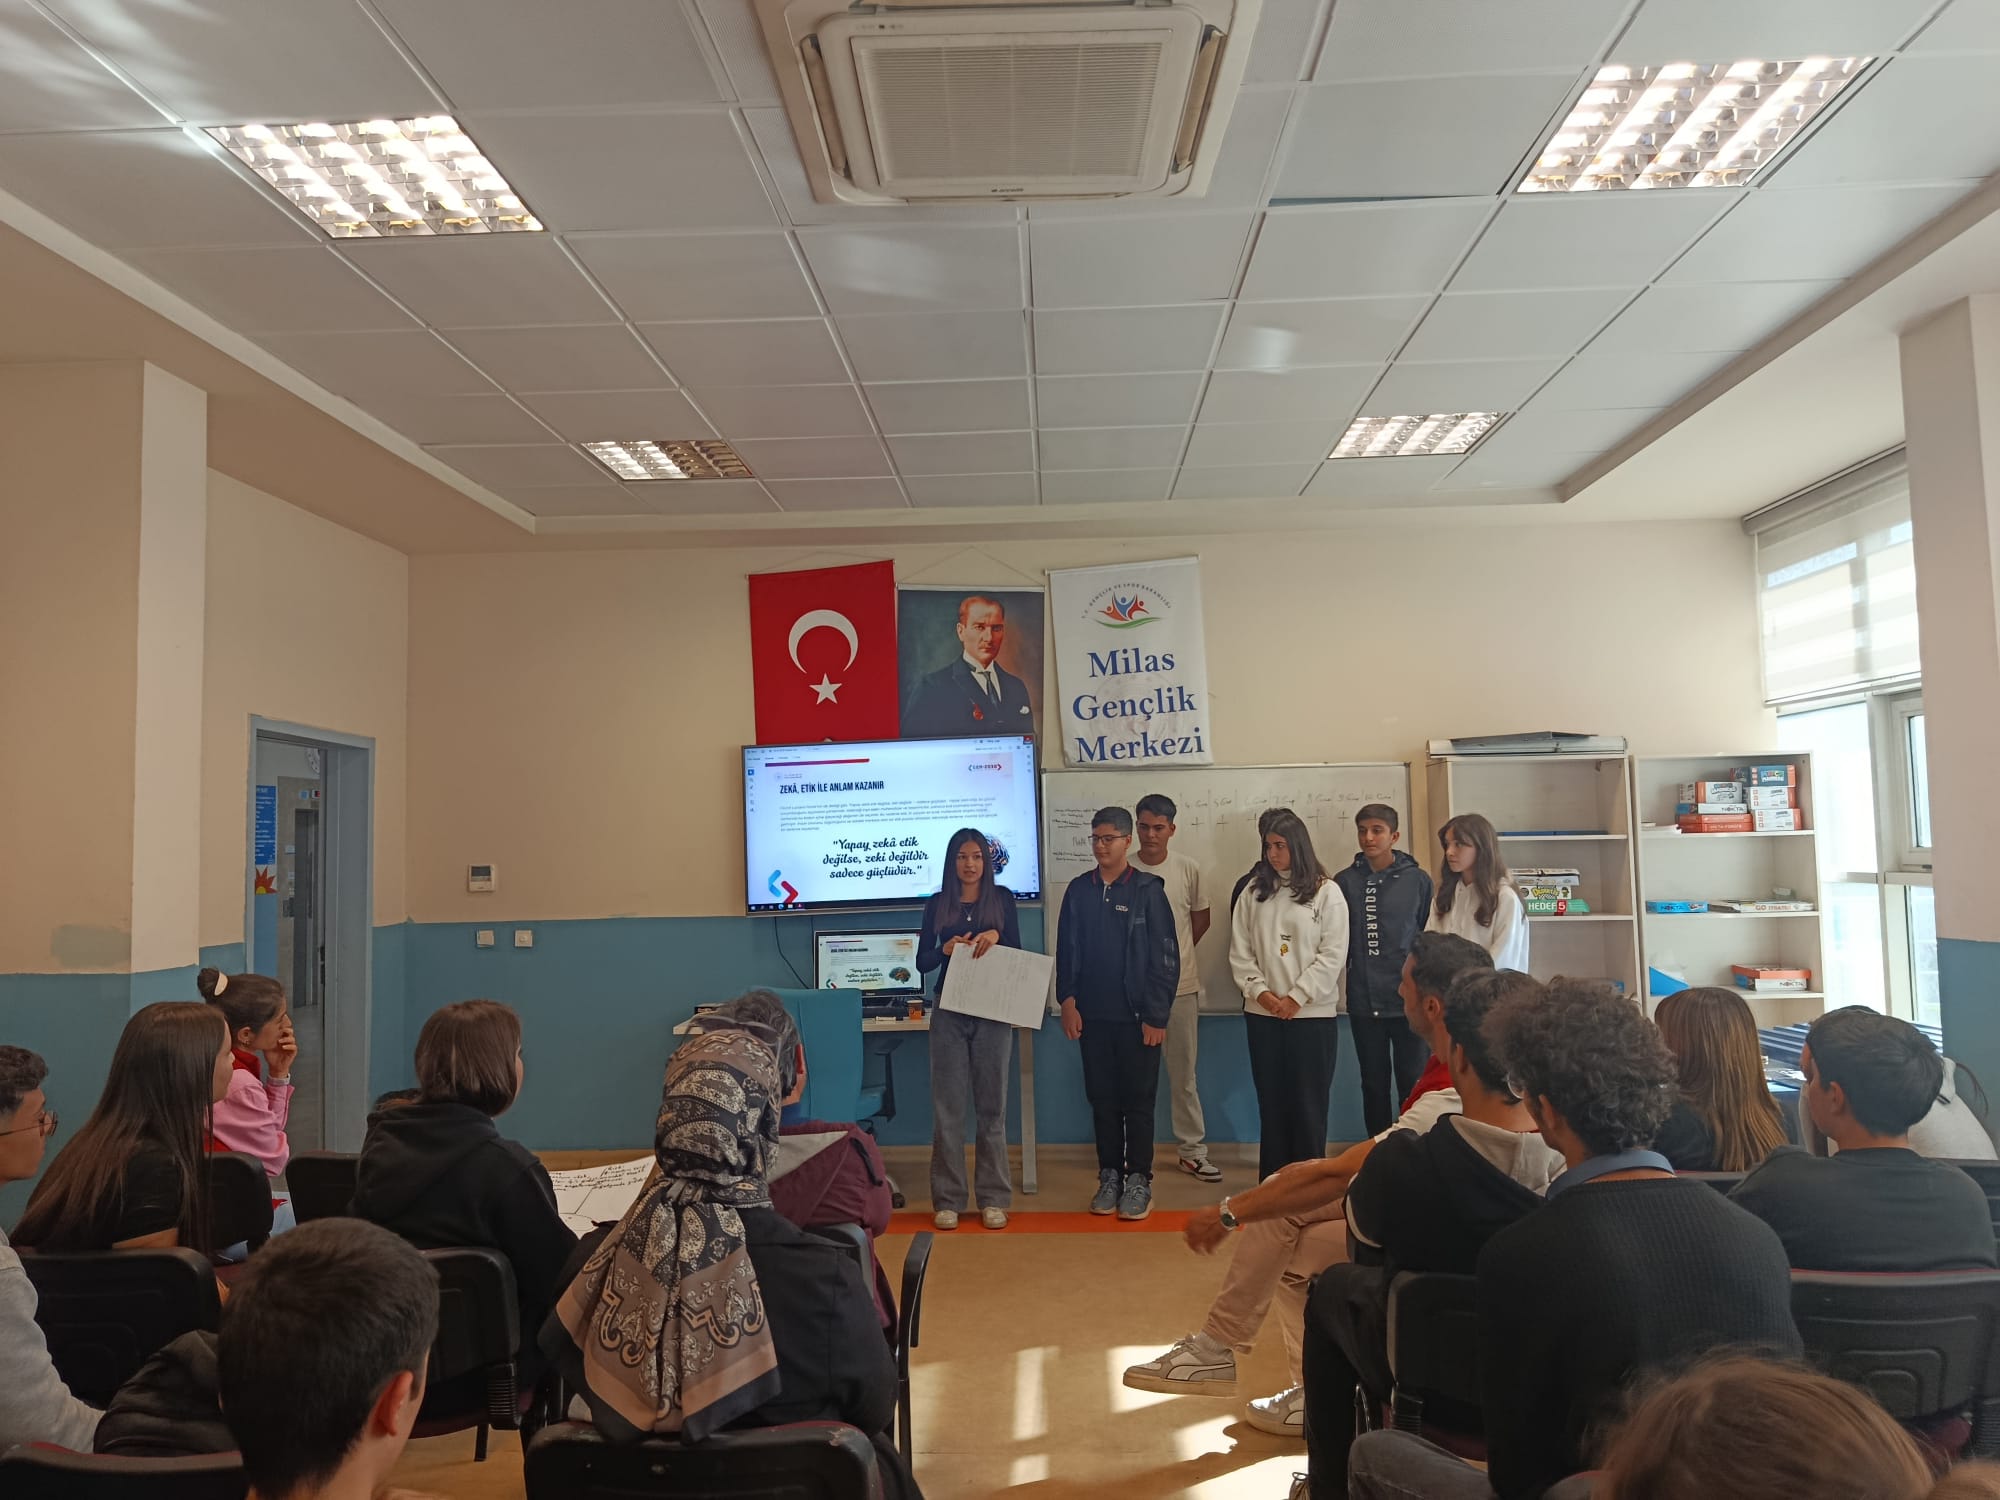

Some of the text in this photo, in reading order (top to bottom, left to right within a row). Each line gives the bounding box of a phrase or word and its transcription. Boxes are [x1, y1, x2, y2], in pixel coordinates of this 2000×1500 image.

[1087, 647, 1175, 677] Milas
[1072, 685, 1197, 721] Gençlik
[1075, 726, 1205, 763] Merkezi
[801, 782, 816, 793] ETİK
[817, 780, 828, 792] İLE
[829, 781, 854, 792] ANLAM
[855, 780, 885, 791] KAZANIR
[833, 836, 919, 852] "Yapay zekâ etik
[822, 850, 929, 867] değilse, zeki değildir
[829, 865, 922, 880] sadece güçlüdür."
[1528, 901, 1566, 911] HEDEF 5
